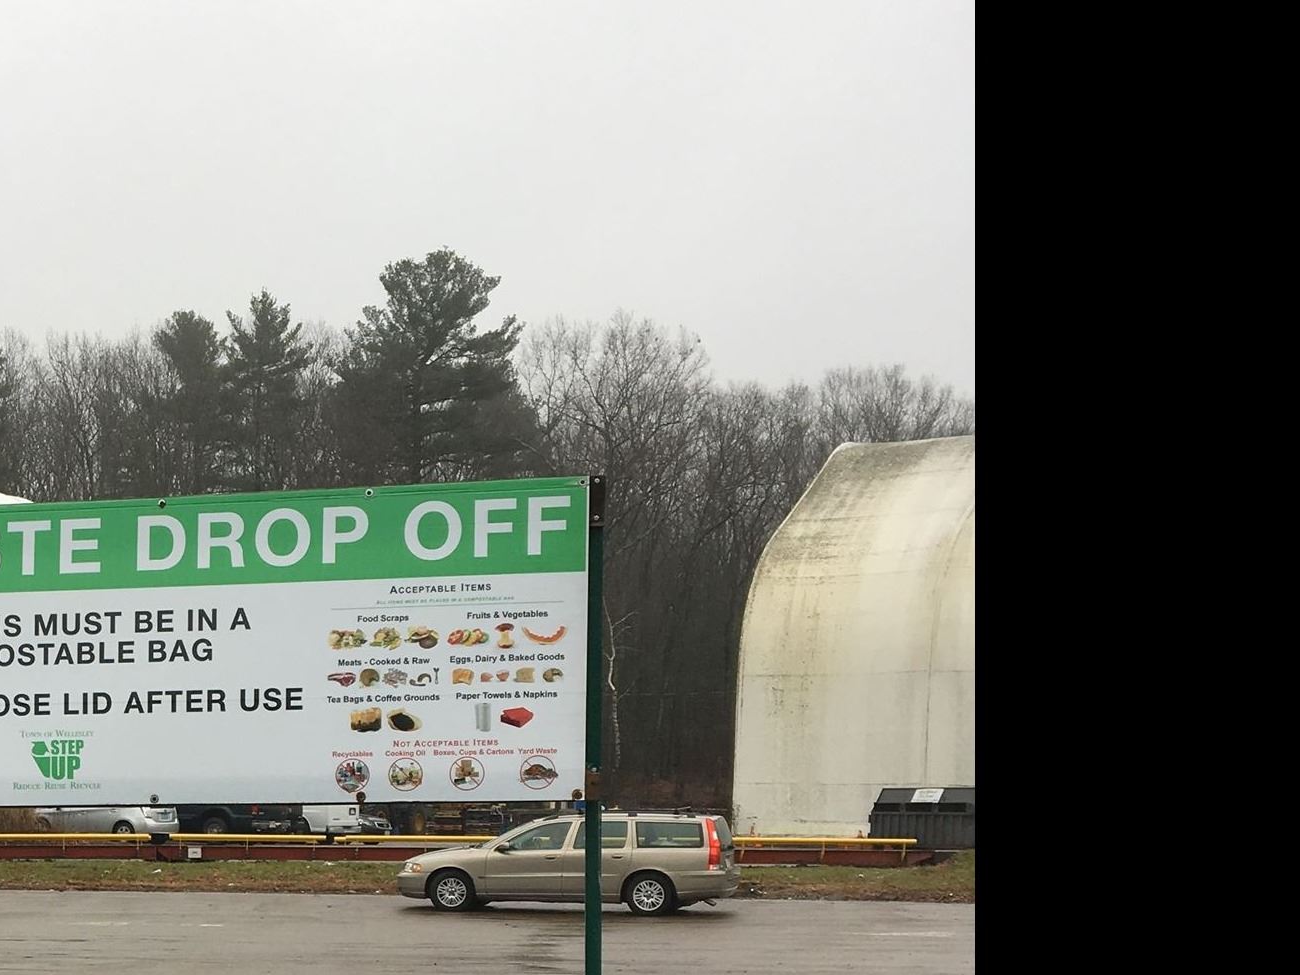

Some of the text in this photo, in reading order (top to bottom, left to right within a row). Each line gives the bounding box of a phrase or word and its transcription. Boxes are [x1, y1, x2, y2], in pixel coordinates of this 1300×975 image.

[136, 505, 369, 572] DROP
[404, 496, 572, 561] OFF
[390, 583, 492, 594] ACCEPTABLE ITEMS
[357, 614, 409, 623] Food Scraps
[467, 611, 491, 620] Fruits
[502, 610, 548, 620] Vegetables
[34, 611, 122, 636] MUST
[134, 610, 175, 633] BE
[187, 608, 218, 631] IN
[230, 607, 251, 630] A
[148, 638, 214, 663] BAG
[338, 659, 362, 667] Meats
[369, 657, 402, 666] Cooked
[403, 657, 410, 665] &
[412, 657, 430, 665] Raw
[449, 653, 565, 664] Eggs, Dairy & Baked Goods
[64, 692, 112, 715] LID
[124, 689, 226, 713] AFTER
[240, 687, 304, 712] USE
[327, 695, 341, 703] Tea
[343, 695, 364, 704] Bags
[374, 694, 402, 702] Coffee
[404, 693, 440, 701] Grounds
[456, 690, 558, 701] Paper Towels & Napkins
[50, 740, 84, 755] STEP
[393, 738, 499, 748] NOT ACCEPTABLE ITEMS
[51, 756, 81, 780] UP
